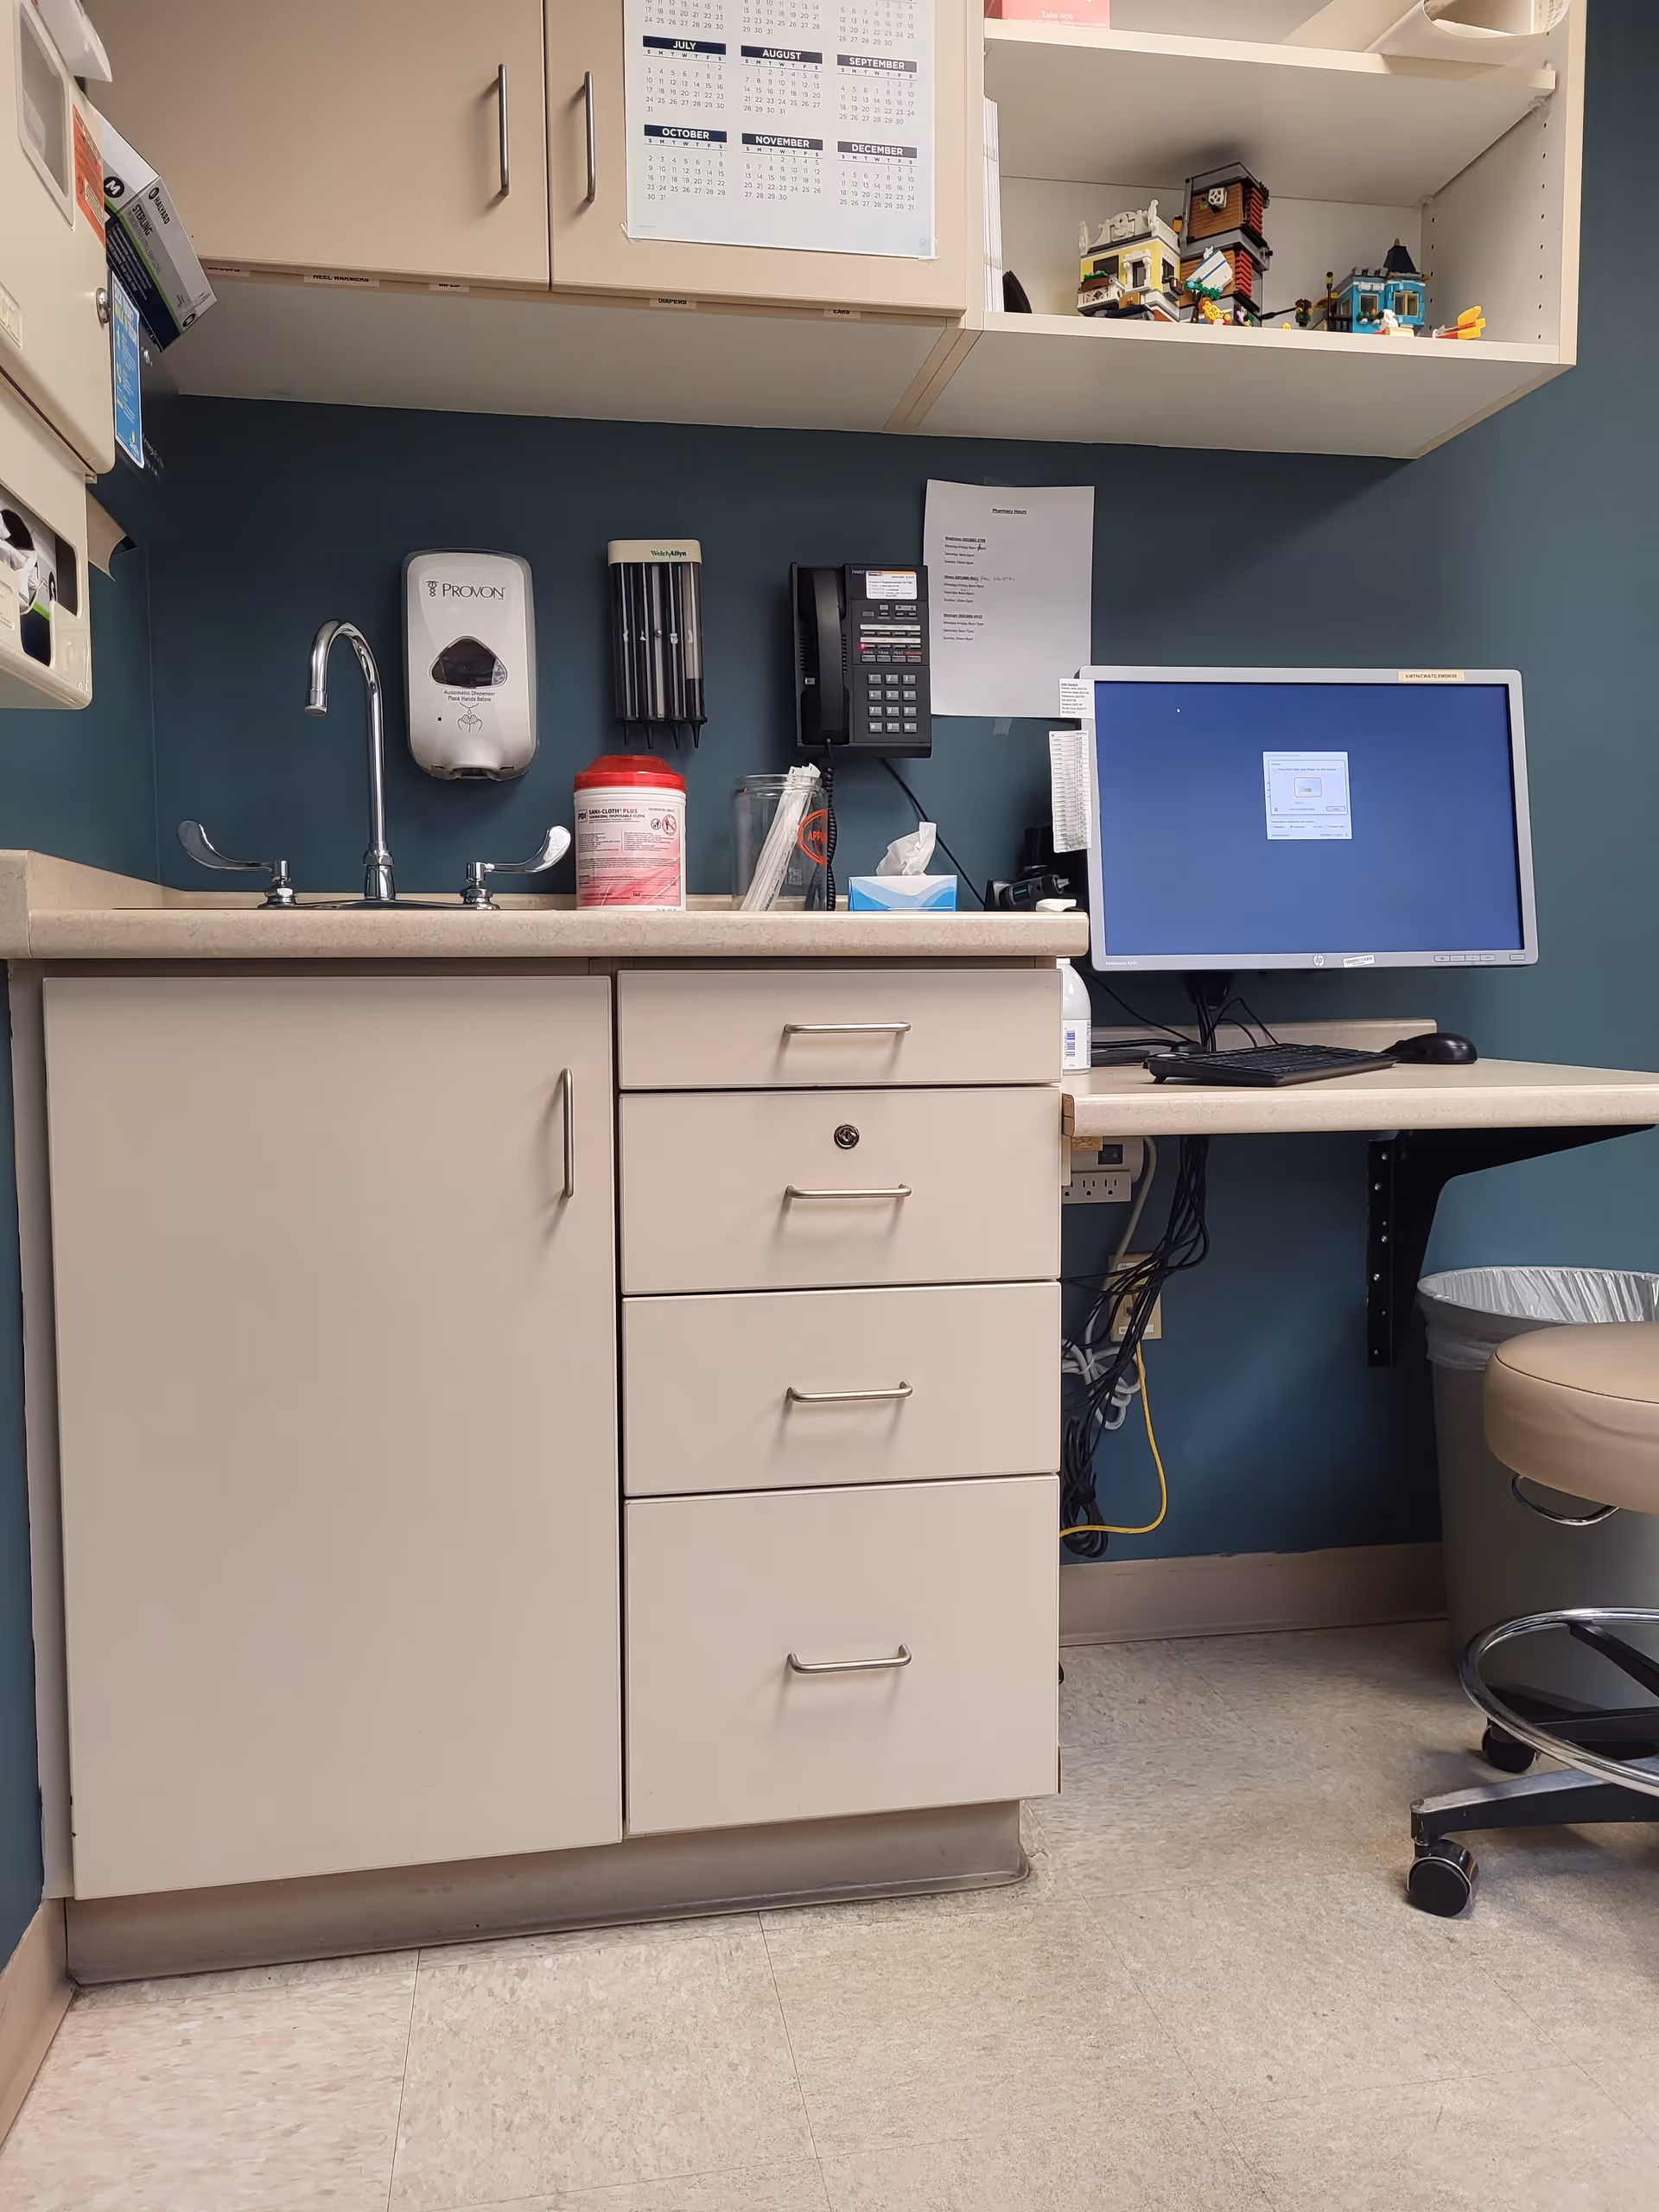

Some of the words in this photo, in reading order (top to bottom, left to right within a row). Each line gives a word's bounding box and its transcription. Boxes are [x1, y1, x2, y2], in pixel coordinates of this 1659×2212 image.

[1041, 10, 1058, 19] Take
[673, 40, 696, 50] JULY
[762, 49, 801, 60] AUGUST
[849, 57, 906, 70] SEPTEMBER
[662, 128, 709, 140] OCTOBER
[755, 136, 810, 148] NOVEMBER
[851, 144, 903, 156] DECEMBER
[105, 180, 121, 195] M
[153, 196, 170, 225] HALYARD
[132, 204, 153, 236] STERLING
[442, 583, 505, 600] PROVON
